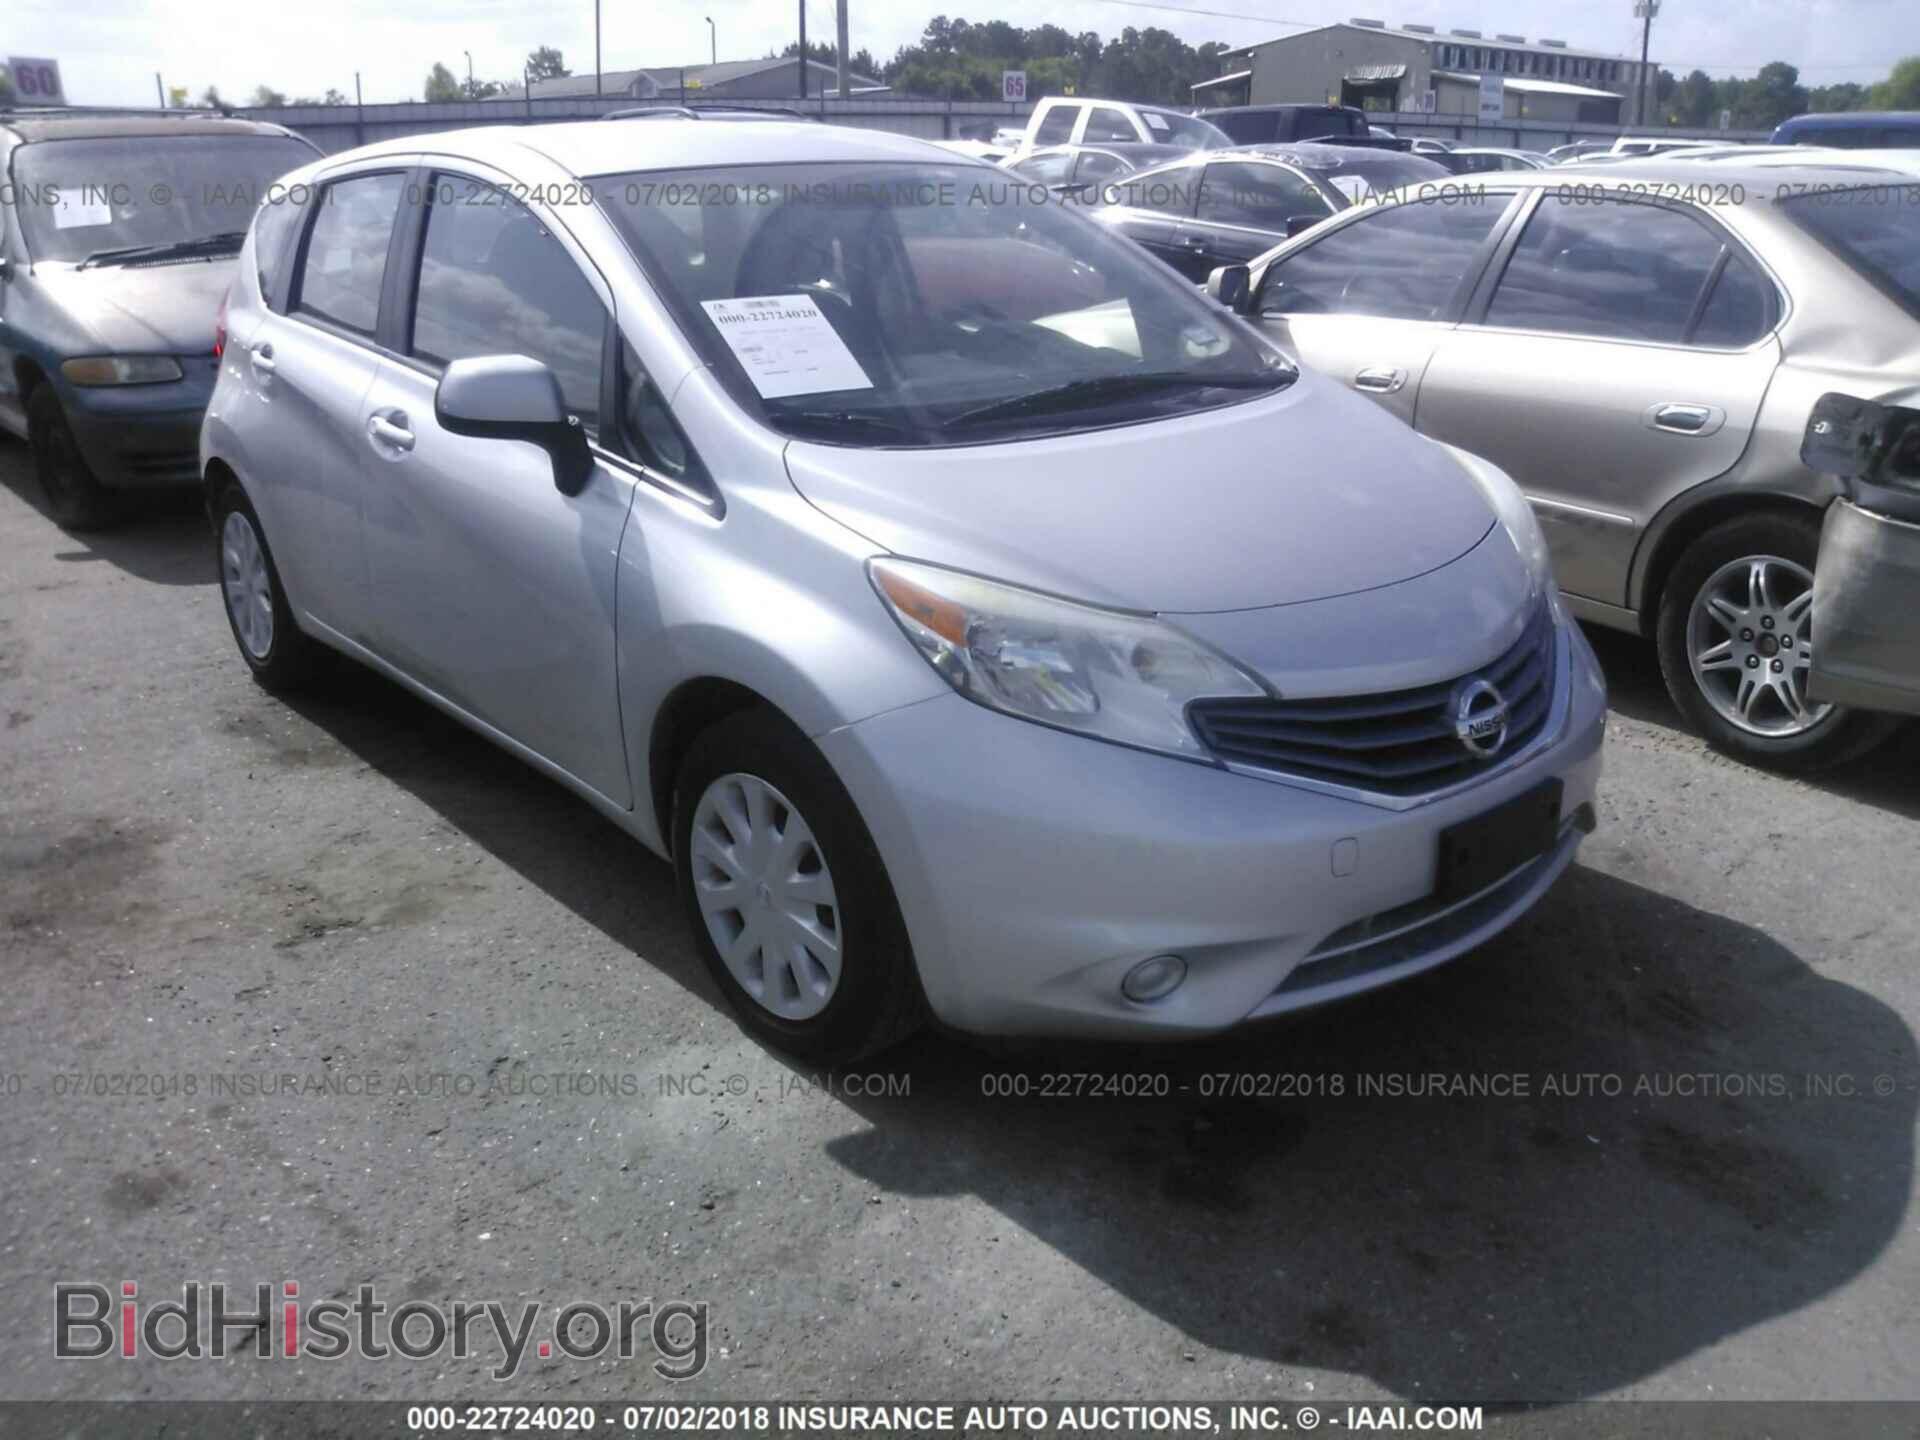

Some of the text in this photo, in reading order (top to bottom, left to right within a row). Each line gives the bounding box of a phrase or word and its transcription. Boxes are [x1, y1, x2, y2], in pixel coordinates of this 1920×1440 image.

[16, 64, 59, 95] 60
[1006, 75, 1024, 96] 65
[718, 309, 818, 325] 000-22724020
